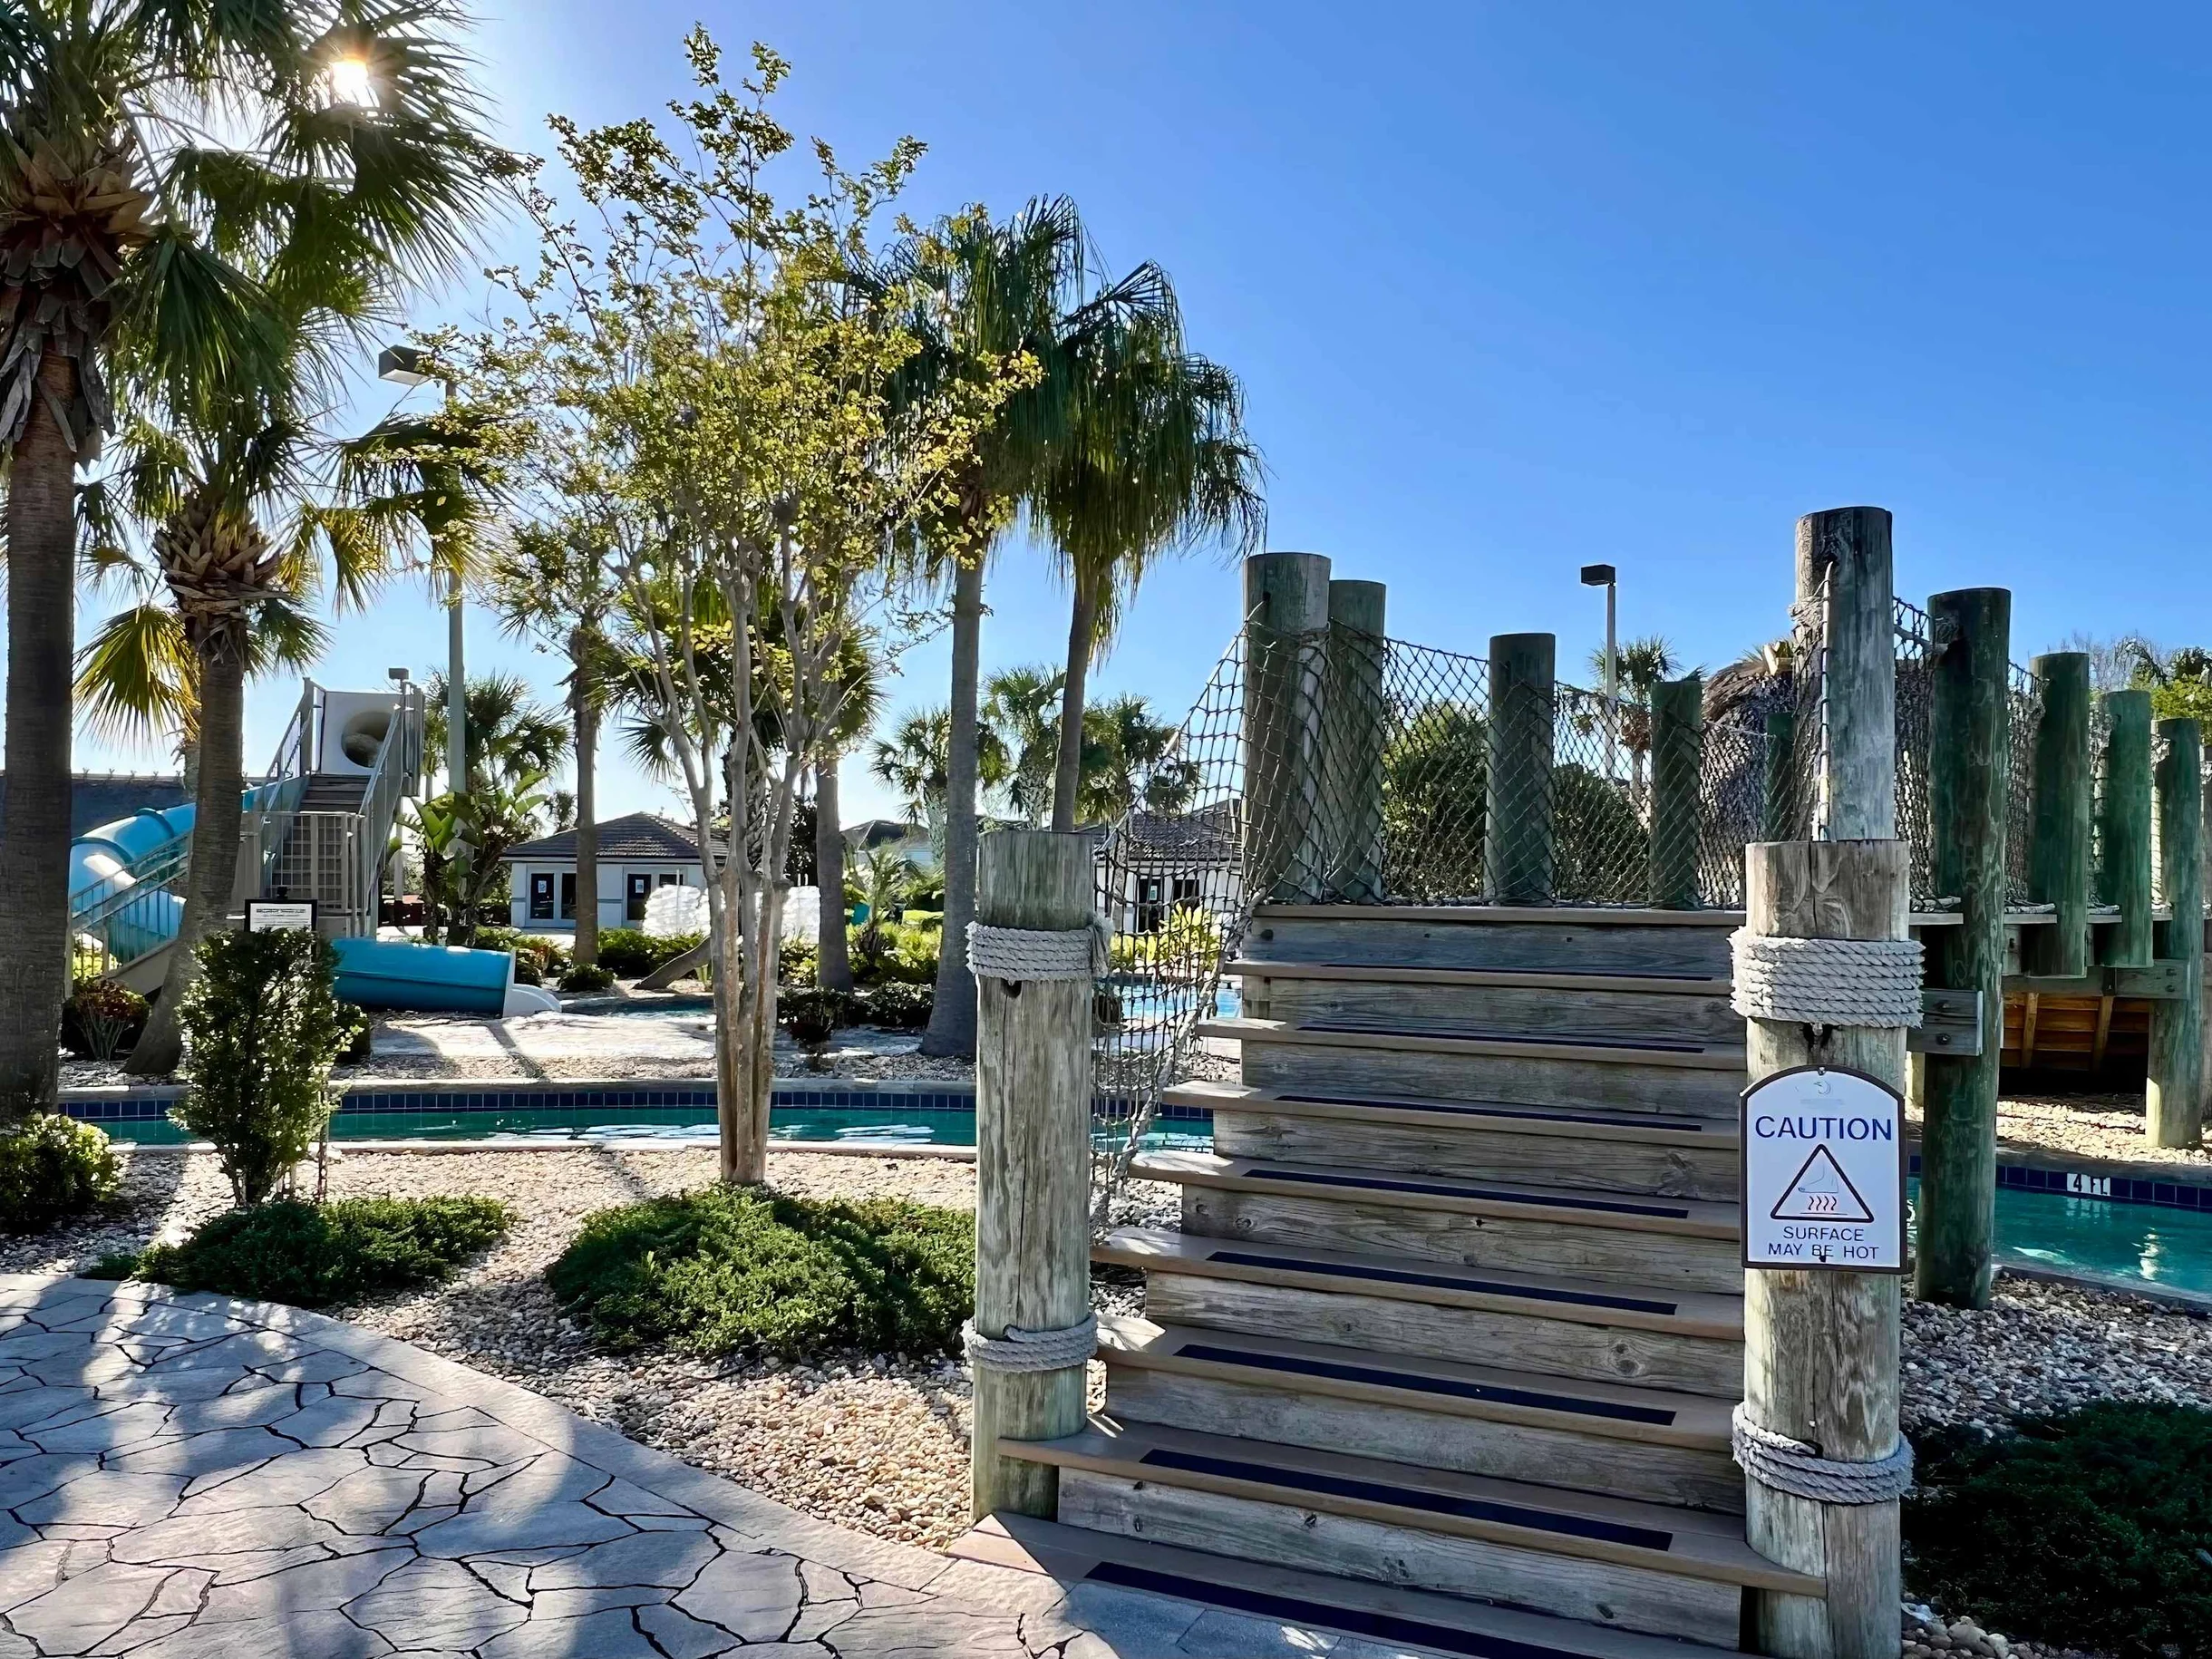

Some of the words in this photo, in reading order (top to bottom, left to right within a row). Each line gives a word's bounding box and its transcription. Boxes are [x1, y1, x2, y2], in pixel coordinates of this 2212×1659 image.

[1755, 1116, 1891, 1140] CAUTION
[2073, 1173, 2082, 1192] 4
[1783, 1226, 1864, 1241] SURFACE
[1768, 1242, 1802, 1256] MAY
[1811, 1244, 1834, 1257] BE
[1843, 1246, 1879, 1259] HOT
